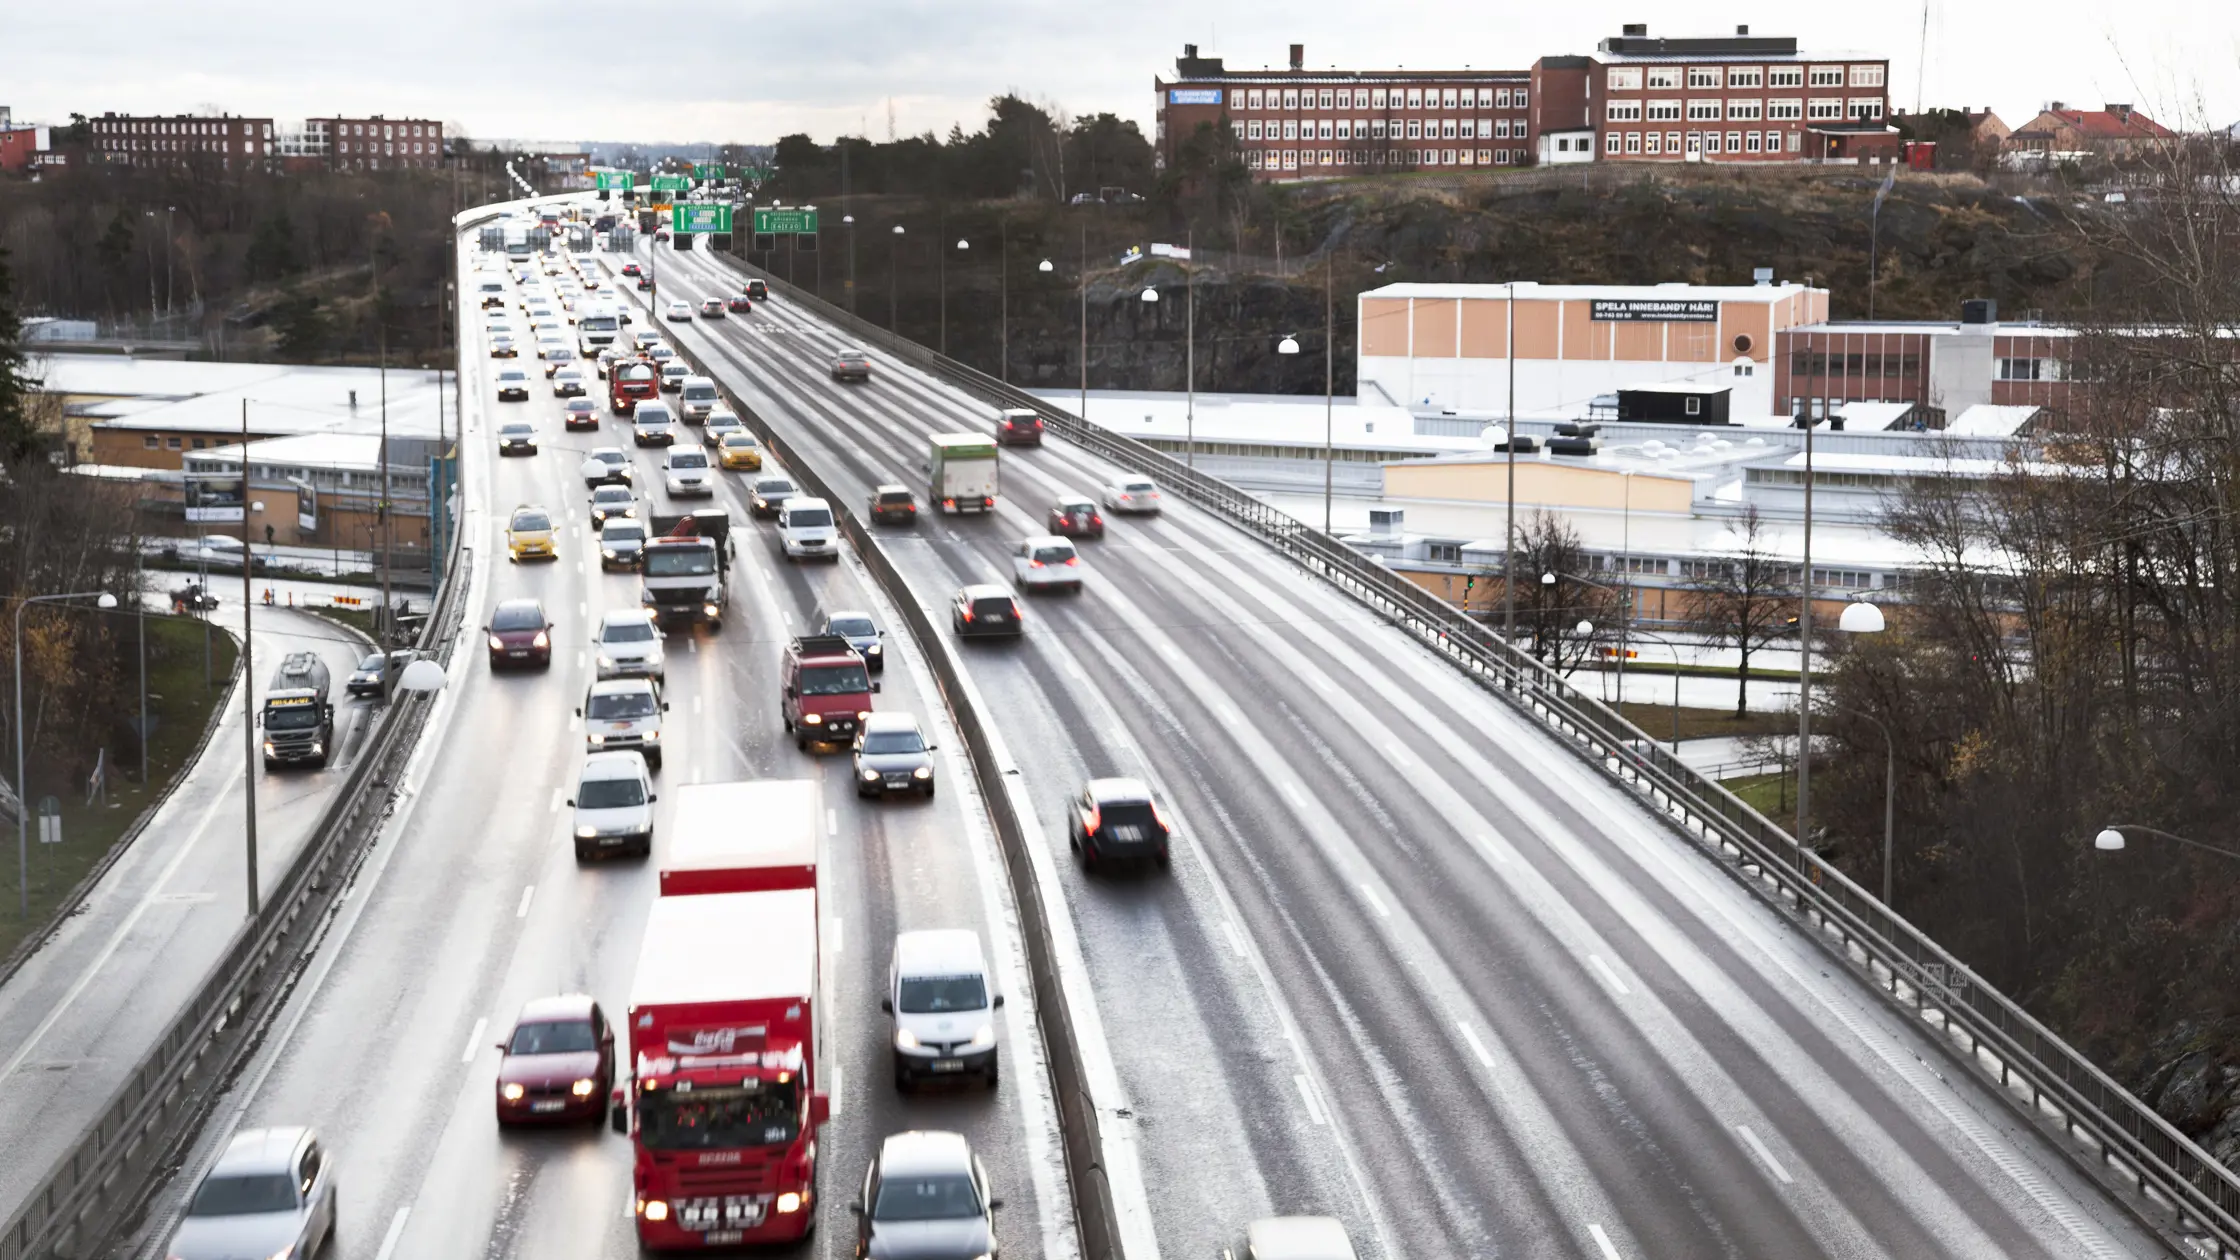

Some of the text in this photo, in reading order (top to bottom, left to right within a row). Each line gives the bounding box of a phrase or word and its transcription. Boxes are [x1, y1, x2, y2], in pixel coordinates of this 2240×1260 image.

[1595, 302, 1714, 312] SPELA INNEBANDY HÄR!
